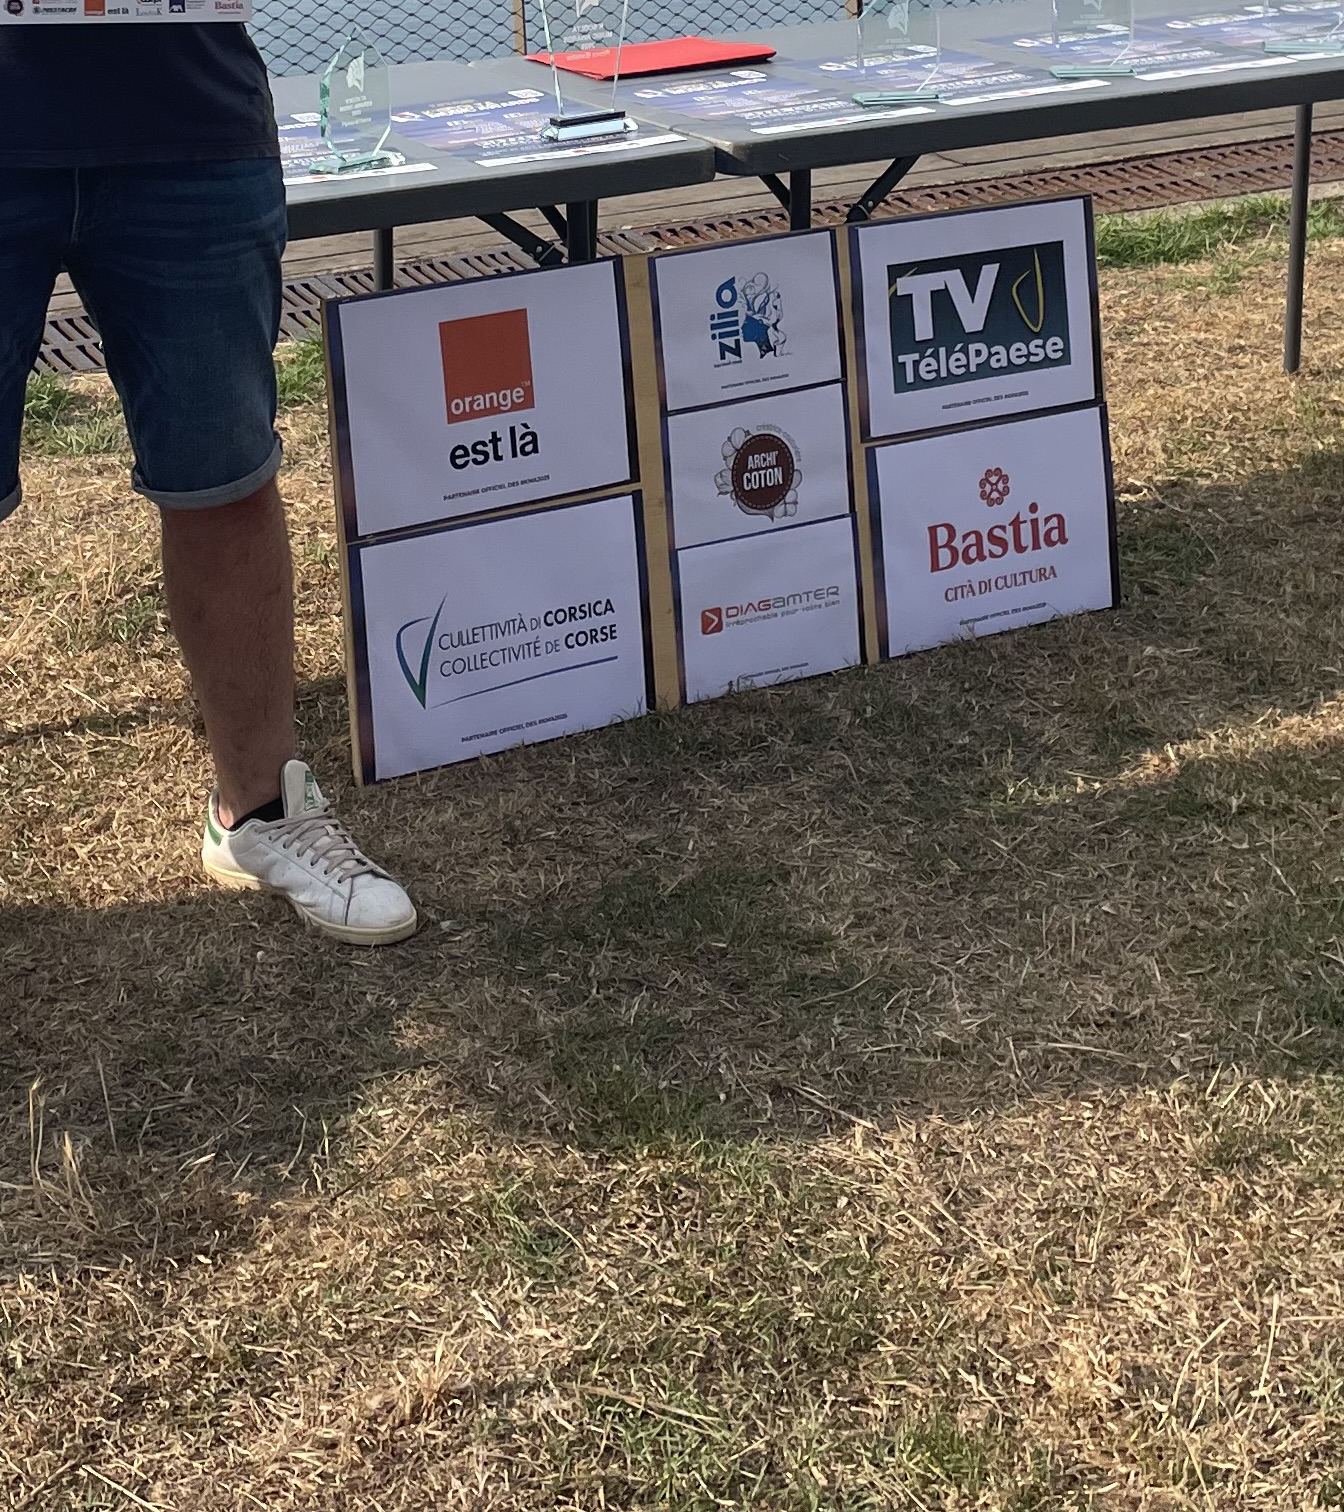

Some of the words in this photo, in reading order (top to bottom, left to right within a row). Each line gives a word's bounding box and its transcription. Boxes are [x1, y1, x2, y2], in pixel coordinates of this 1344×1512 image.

[897, 263, 1000, 341] TV
[898, 336, 1064, 383] TéléPaese
[451, 387, 524, 415] orange
[449, 431, 504, 470] est
[509, 422, 539, 459] là
[743, 467, 783, 491] COTON
[928, 502, 1069, 573] Bastia
[944, 579, 976, 602] CITÀ
[978, 580, 992, 595] DI
[994, 565, 1057, 591] CULTURA
[438, 613, 527, 651] CULLETTIVITÀ
[530, 617, 542, 631] DI
[543, 598, 615, 627] CORSICA
[440, 636, 541, 677] COLLECTIVITÉ
[545, 639, 560, 655] DE
[564, 623, 618, 650] CORSE
